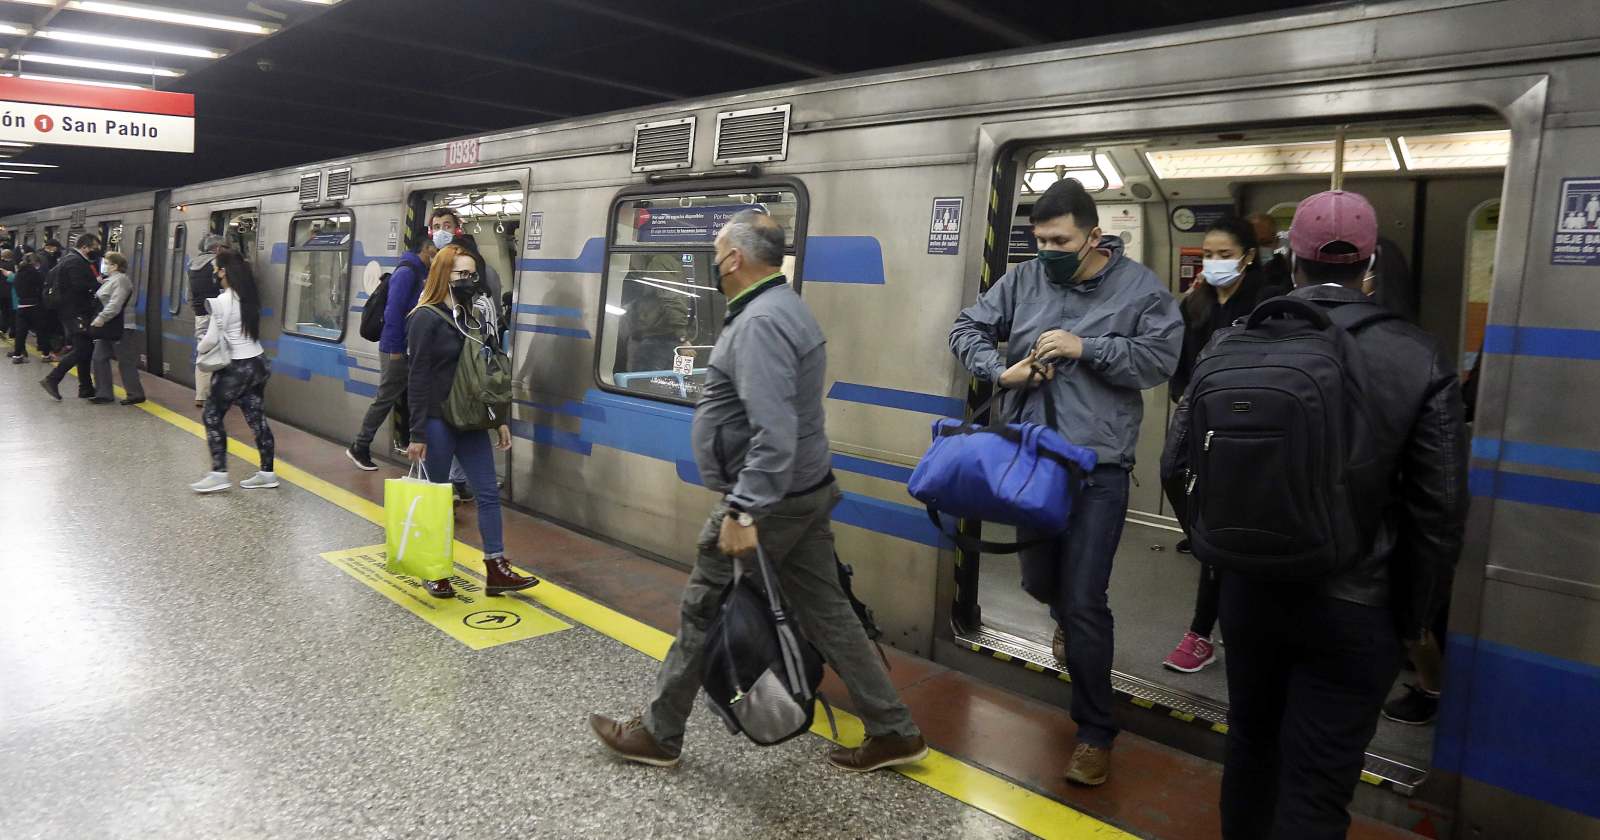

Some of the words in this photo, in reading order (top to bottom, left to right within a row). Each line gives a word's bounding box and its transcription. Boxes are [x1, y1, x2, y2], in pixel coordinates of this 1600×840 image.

[62, 116, 97, 134] San
[105, 120, 158, 138] Pablo
[449, 139, 477, 164] 0933
